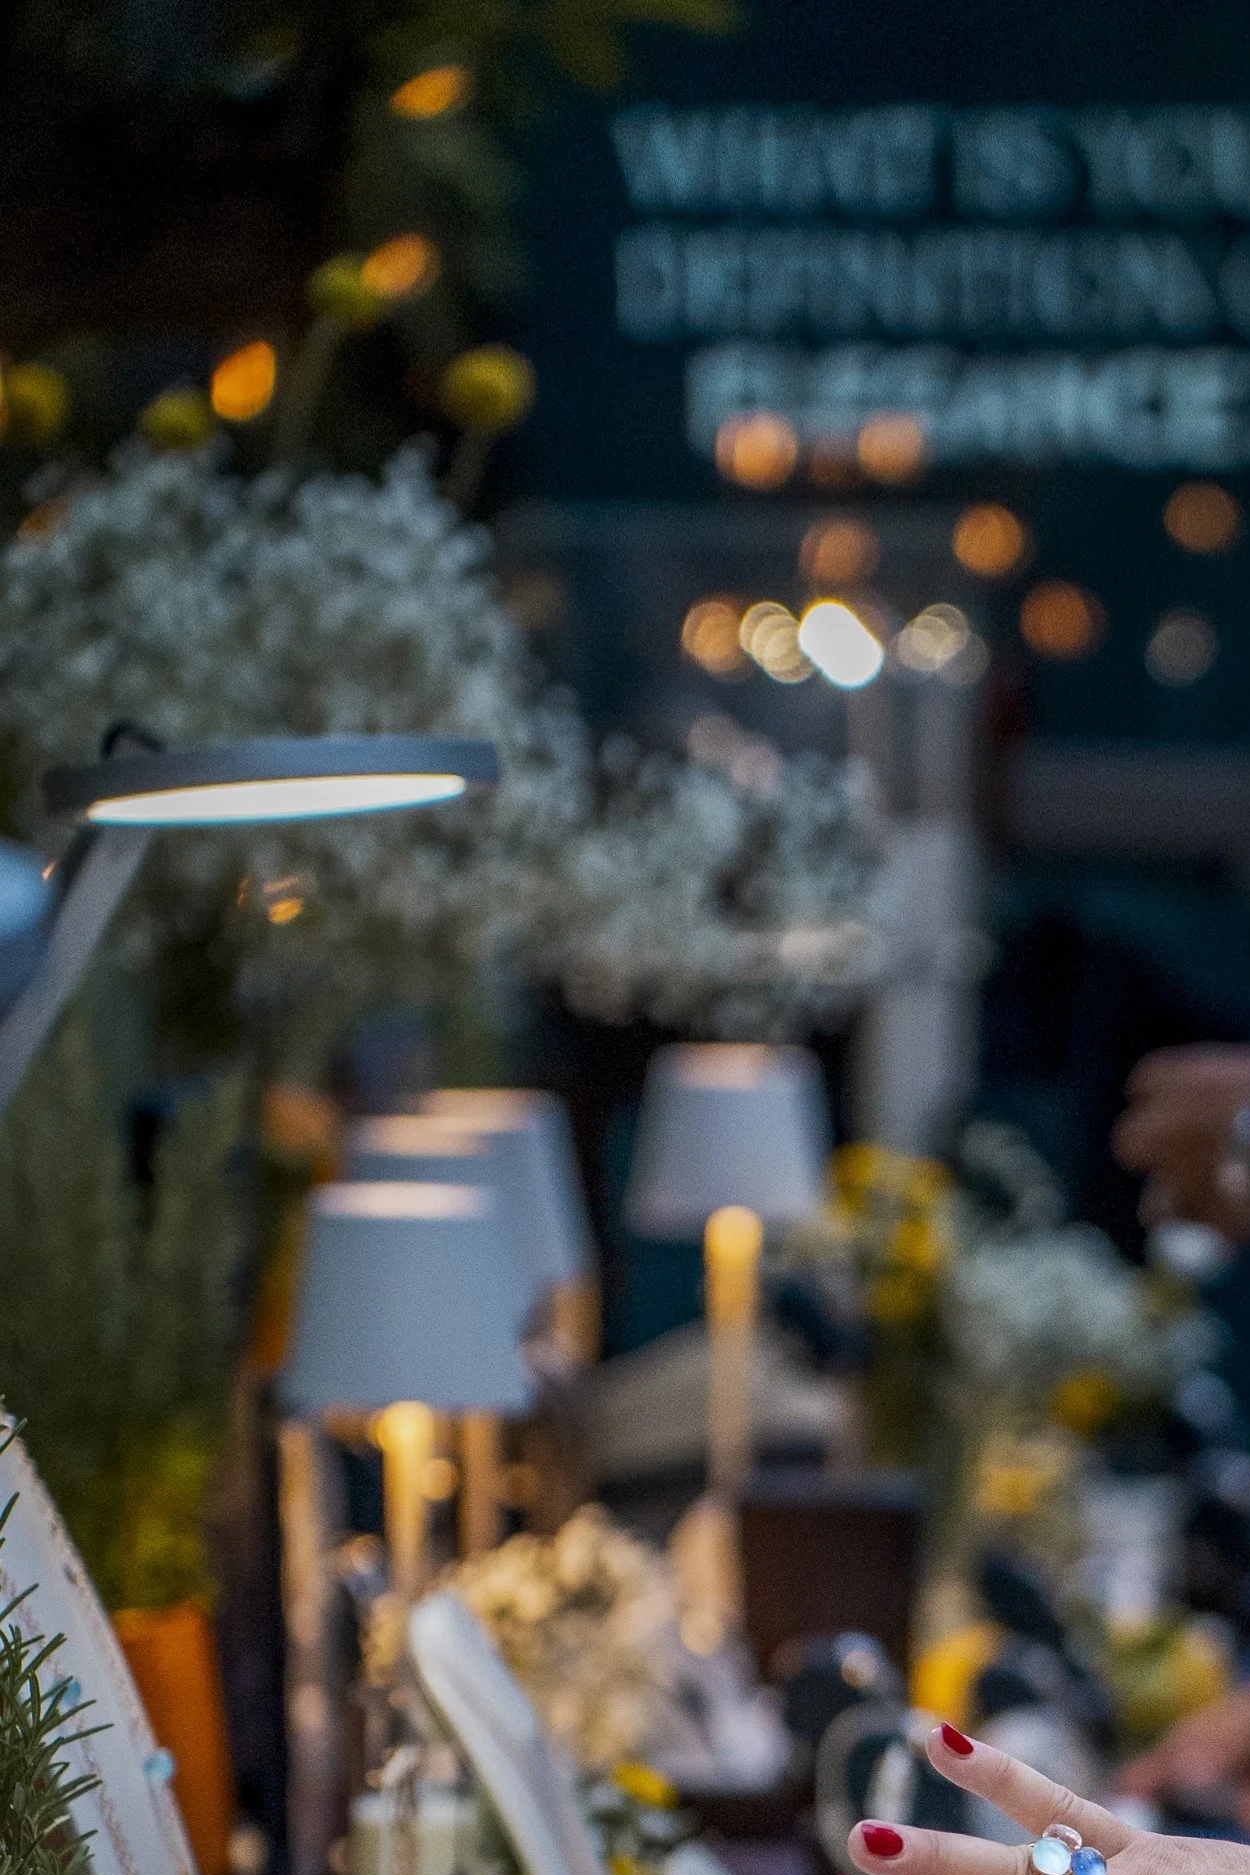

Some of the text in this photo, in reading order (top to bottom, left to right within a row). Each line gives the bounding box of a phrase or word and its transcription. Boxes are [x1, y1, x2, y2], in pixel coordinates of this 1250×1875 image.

[611, 104, 938, 209] WHAT
[951, 104, 1086, 212] IS
[613, 227, 1217, 340] DEFINITION
